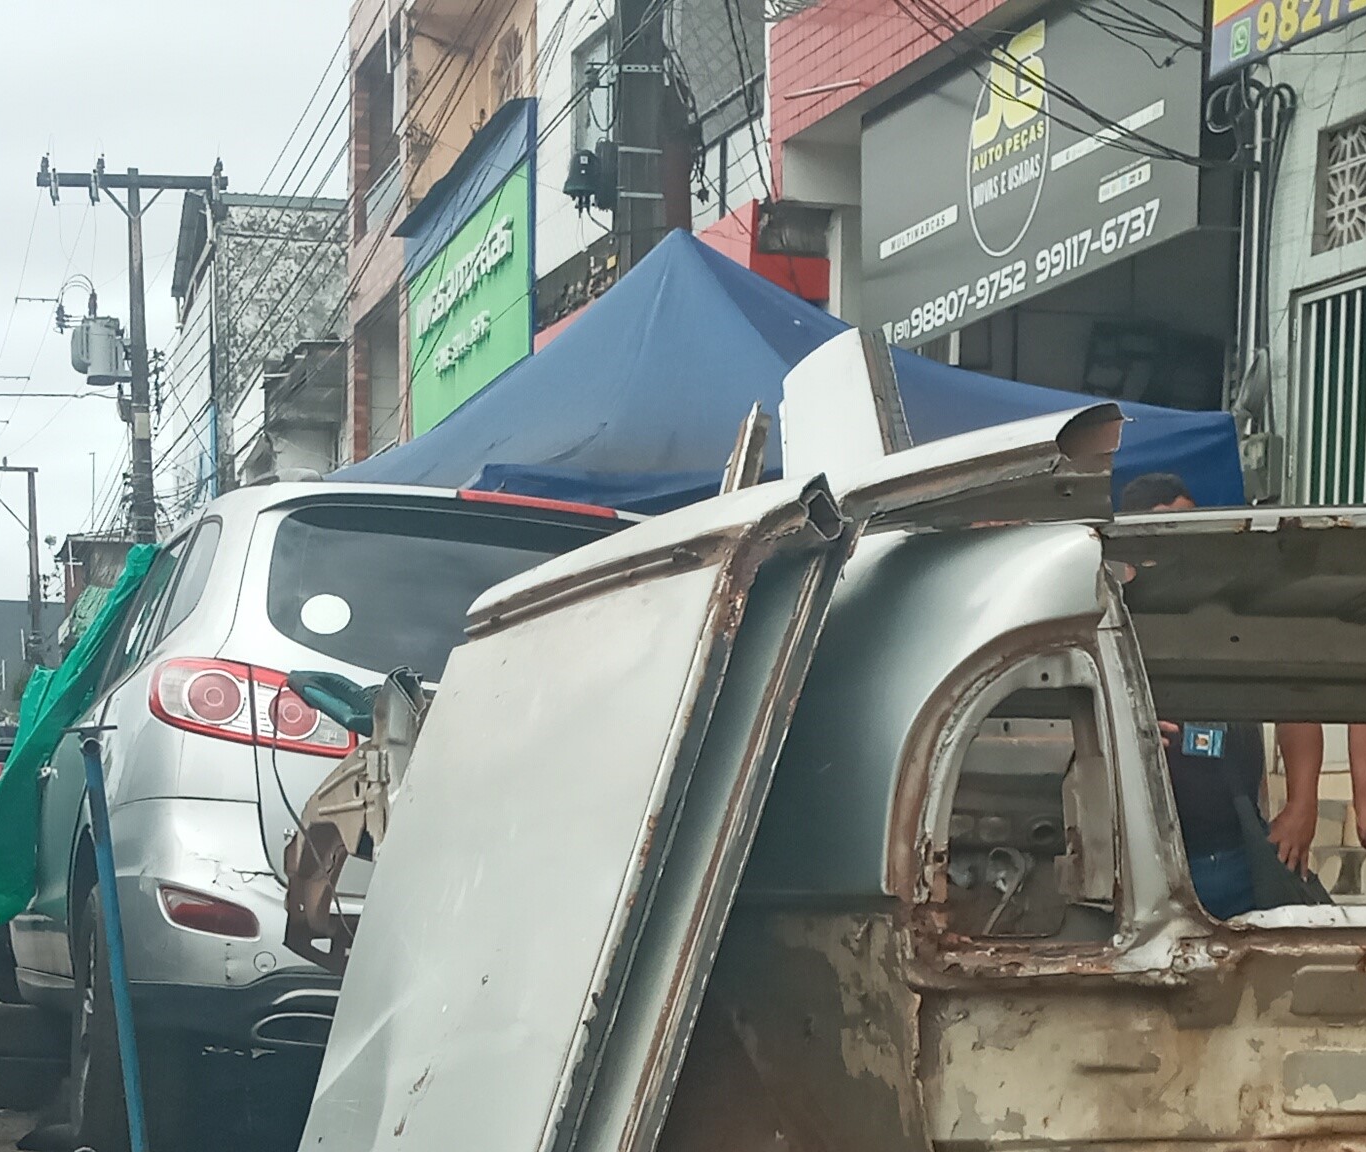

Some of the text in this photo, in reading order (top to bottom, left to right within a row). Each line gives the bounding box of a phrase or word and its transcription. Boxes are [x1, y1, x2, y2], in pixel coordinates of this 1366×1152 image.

[972, 143, 1004, 173] AUTO
[1005, 120, 1045, 156] PEÇAS
[972, 153, 1041, 209] NOVAS E USADAS
[890, 213, 947, 251] MULTIMARCAS
[911, 260, 1027, 338] 98807-9752
[1035, 198, 1160, 284] 99117-6737
